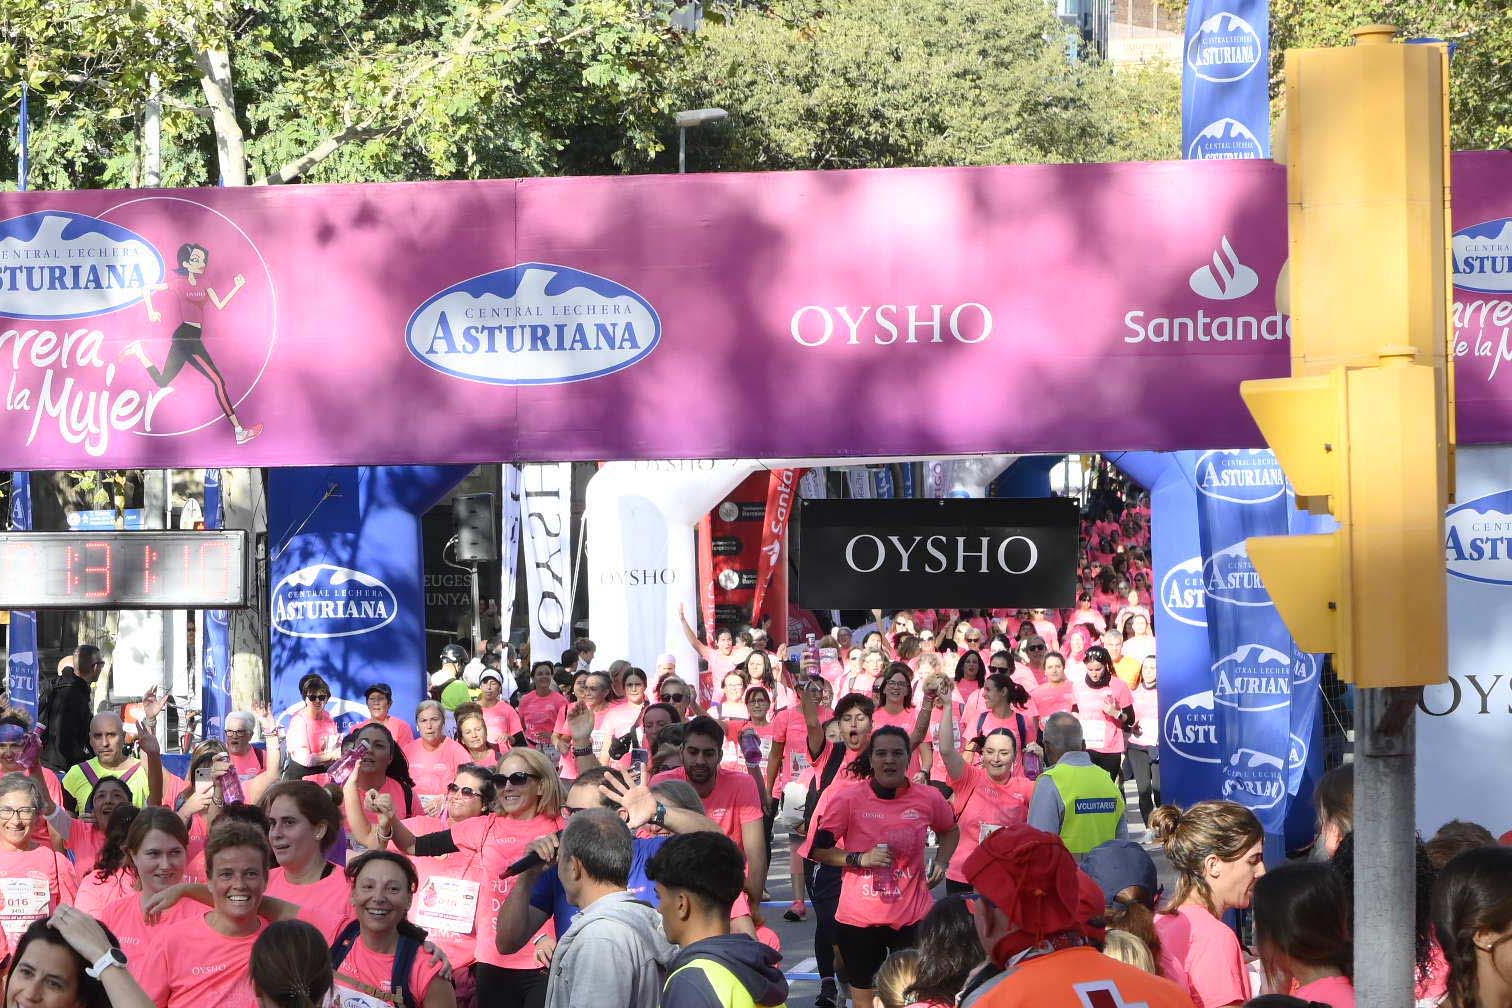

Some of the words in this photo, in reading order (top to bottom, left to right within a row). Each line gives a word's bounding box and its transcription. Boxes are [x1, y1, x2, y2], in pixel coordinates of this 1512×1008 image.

[1195, 42, 1254, 66] ASTURIANA
[68, 246, 141, 259] LECHERA
[465, 305, 544, 318] CENTRAL
[552, 303, 633, 317] LECHERA
[425, 311, 641, 355] ASTURIANA
[790, 302, 994, 347] OYSHO
[6, 371, 32, 411] la
[25, 363, 175, 457] Mujer
[844, 533, 1039, 575] OYSHO
[275, 594, 388, 621] ASTURIANA
[287, 589, 330, 599] CENTRAL
[334, 589, 383, 598] LECHERA
[1417, 673, 1512, 717] OY
[7, 899, 29, 907] 016
